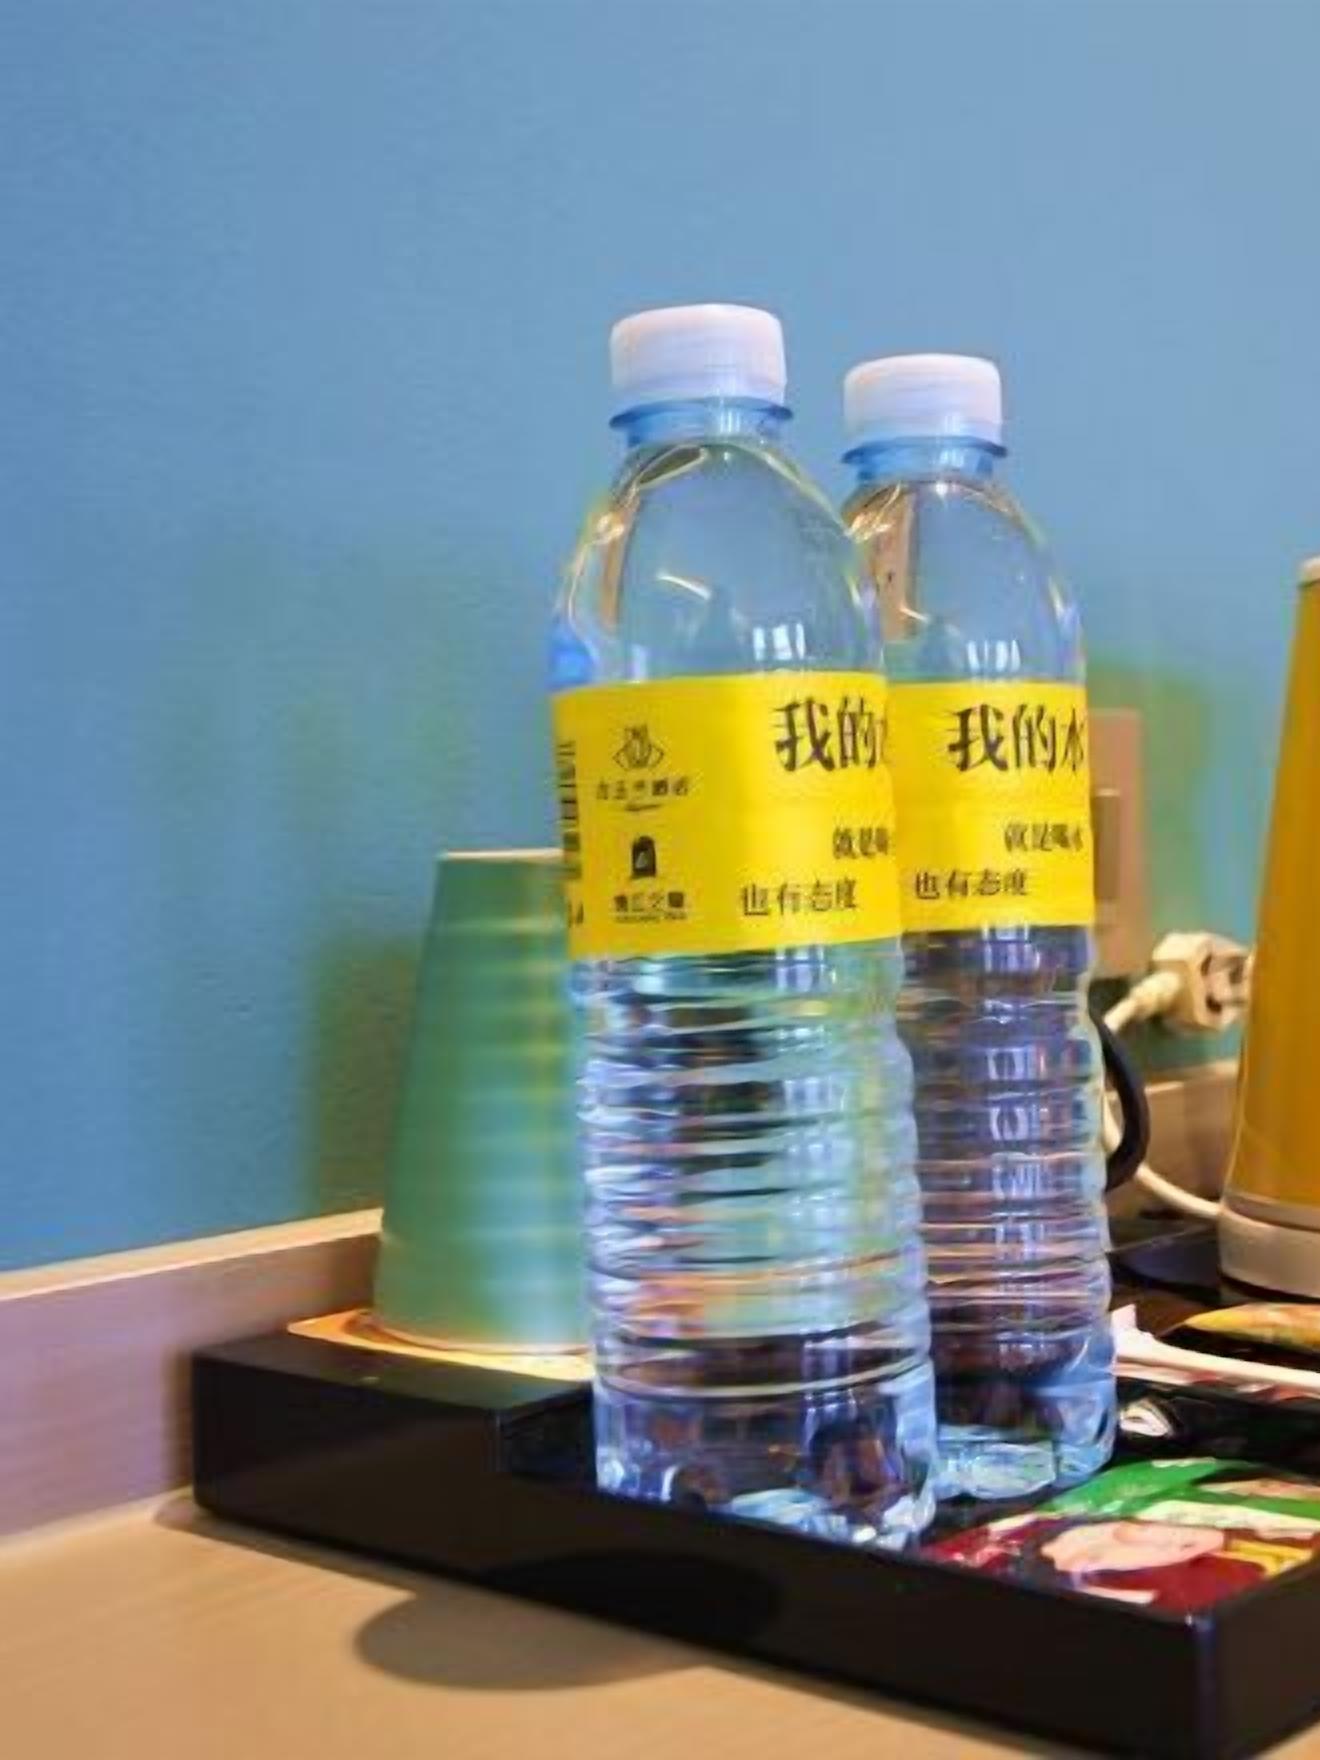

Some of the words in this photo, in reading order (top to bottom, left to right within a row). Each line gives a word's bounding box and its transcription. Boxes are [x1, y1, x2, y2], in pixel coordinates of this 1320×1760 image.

[740, 876, 857, 916] 也有态度
[915, 868, 1027, 900] 也有态度
